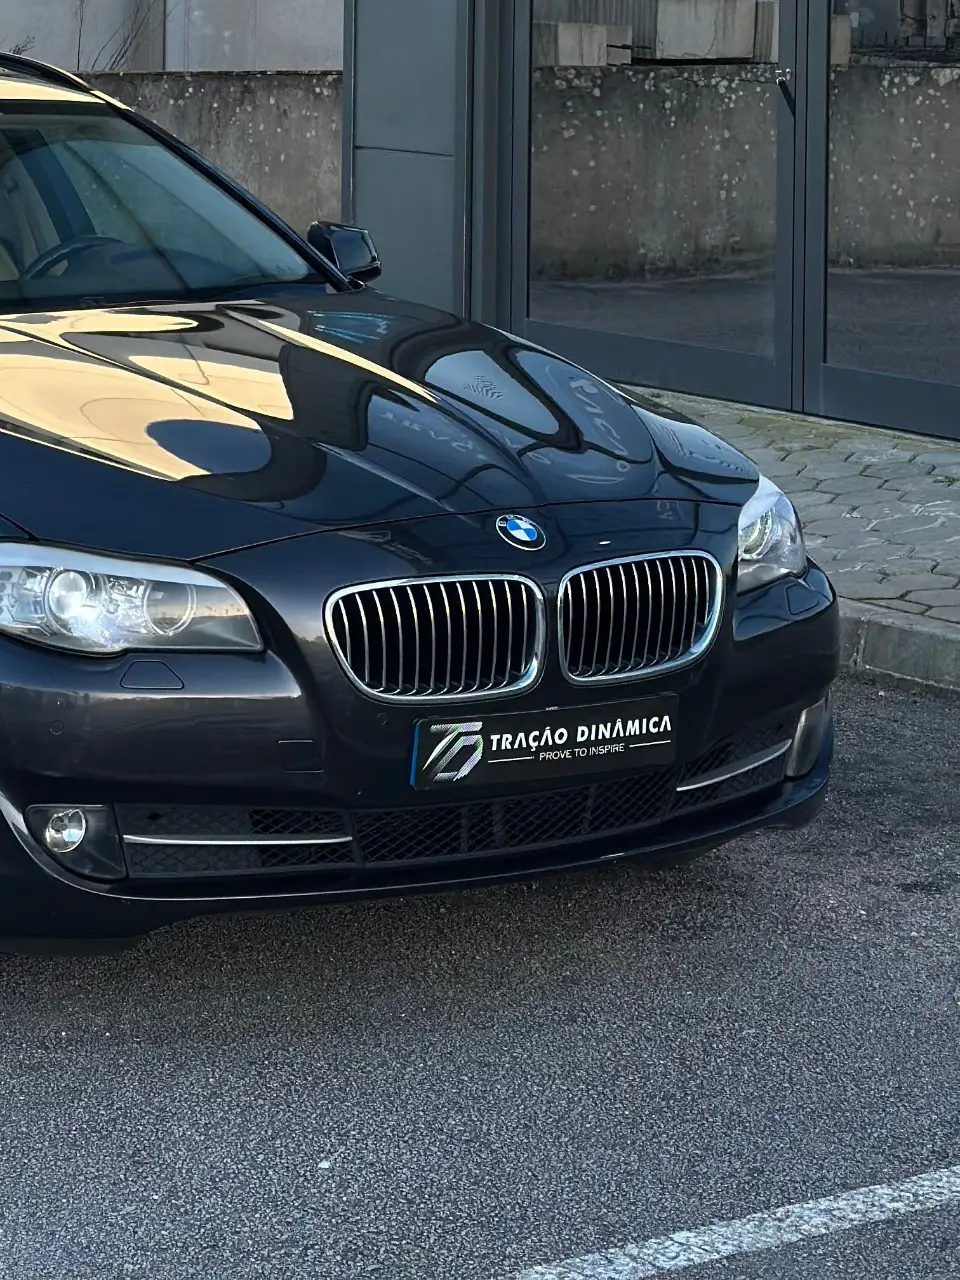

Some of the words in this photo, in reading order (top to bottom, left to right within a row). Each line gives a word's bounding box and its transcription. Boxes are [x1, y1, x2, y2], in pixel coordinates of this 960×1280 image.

[490, 726, 568, 751] TRAÇÃO
[576, 715, 672, 743] DINÂMICA
[539, 749, 572, 761] PROVE
[573, 747, 588, 758] TO
[589, 743, 625, 756] INSPIRE
